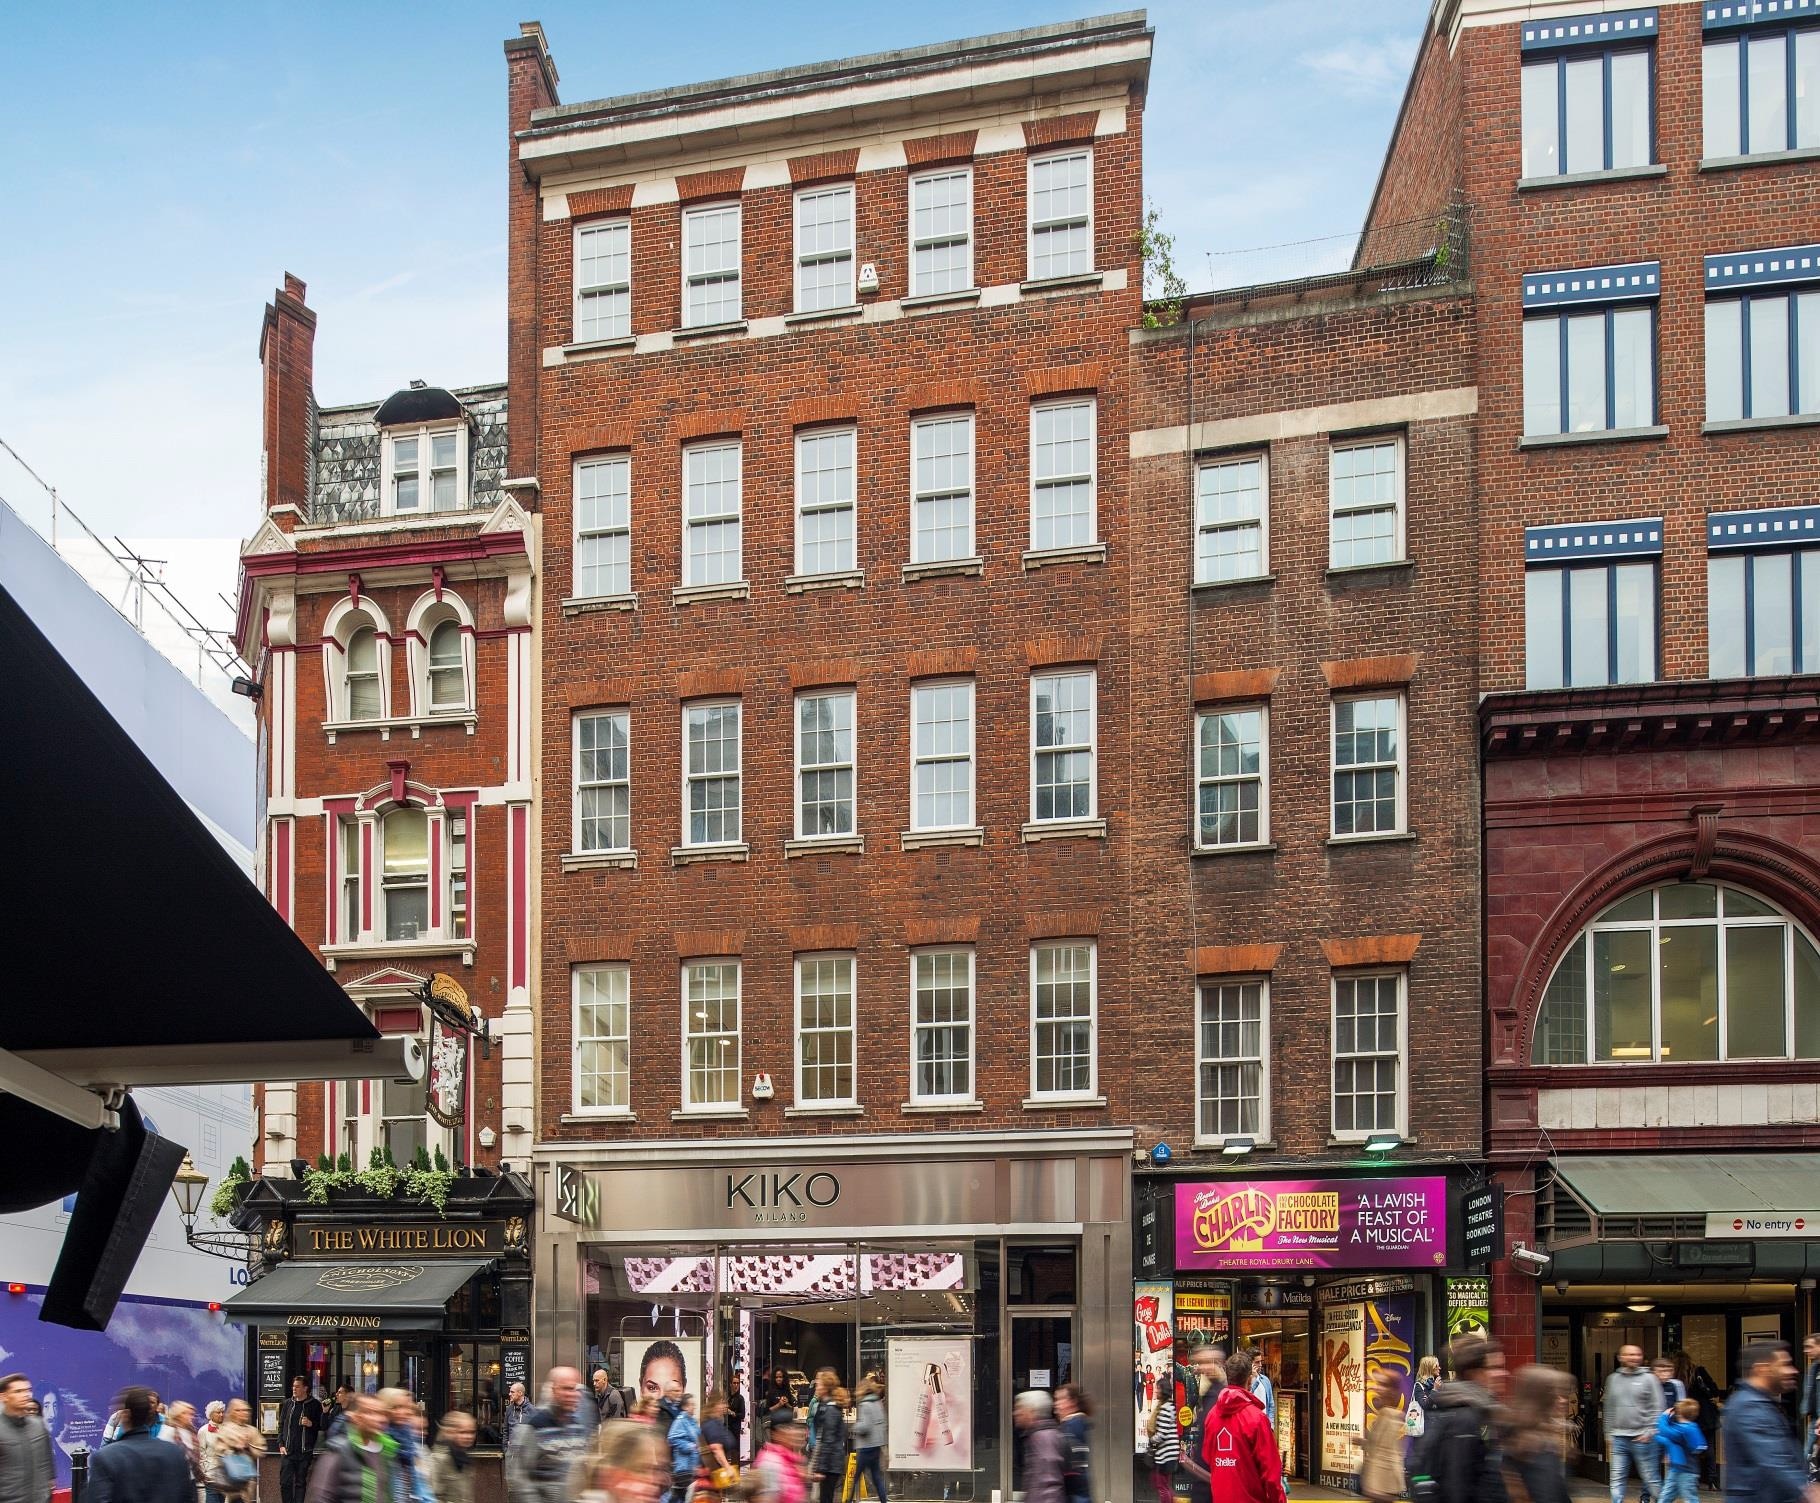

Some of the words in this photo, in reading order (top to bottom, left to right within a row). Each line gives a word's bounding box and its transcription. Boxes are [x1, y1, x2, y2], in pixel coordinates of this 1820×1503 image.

[727, 1172, 841, 1209] KIKO
[1194, 1189, 1216, 1203] Roald
[1288, 1195, 1336, 1208] CHOCOLATE
[1375, 1193, 1425, 1208] LAVISH
[1468, 1194, 1492, 1210] LONDON
[755, 1213, 807, 1222] MILANO
[1195, 1194, 1272, 1243] CHARLIE
[1278, 1209, 1337, 1230] FACTORY
[1358, 1211, 1403, 1226] FEAST
[1407, 1210, 1428, 1225] OF
[1467, 1209, 1493, 1225] THEATRE
[1466, 1223, 1495, 1240] BOOKINGS
[1746, 1219, 1762, 1230] No
[1764, 1219, 1792, 1232] entry
[310, 1229, 354, 1250] THE
[356, 1228, 429, 1249] WHITE
[433, 1227, 487, 1248] LION
[1278, 1235, 1292, 1244] The
[1293, 1236, 1307, 1244] New
[1308, 1235, 1338, 1244] Musical
[1350, 1229, 1362, 1243] A
[1365, 1227, 1435, 1243] MUSICAL'
[1480, 1245, 1491, 1255] 1970
[1218, 1258, 1249, 1266] THEATRE
[1250, 1258, 1270, 1266] ROYAL
[1271, 1257, 1294, 1265] DRURY
[1296, 1257, 1313, 1265] LANE
[1283, 1293, 1312, 1303] Matilda
[1318, 1287, 1340, 1300] HALF
[1341, 1284, 1367, 1298] PRICE
[1367, 1284, 1374, 1294] &
[1186, 1298, 1204, 1307] LEGEND
[1136, 1303, 1153, 1322] Guys
[1384, 1313, 1402, 1324] Disney
[287, 1315, 339, 1327] UPSTAIRS
[340, 1316, 381, 1328] DINING
[1176, 1316, 1229, 1331] THRILLER
[1149, 1325, 1171, 1345] Dolls
[1211, 1332, 1229, 1345] Live
[1340, 1423, 1360, 1431] MUSICAL
[1215, 1457, 1237, 1467] Shelter
[1319, 1475, 1341, 1488] HALF
[1343, 1477, 1357, 1491] PRI
